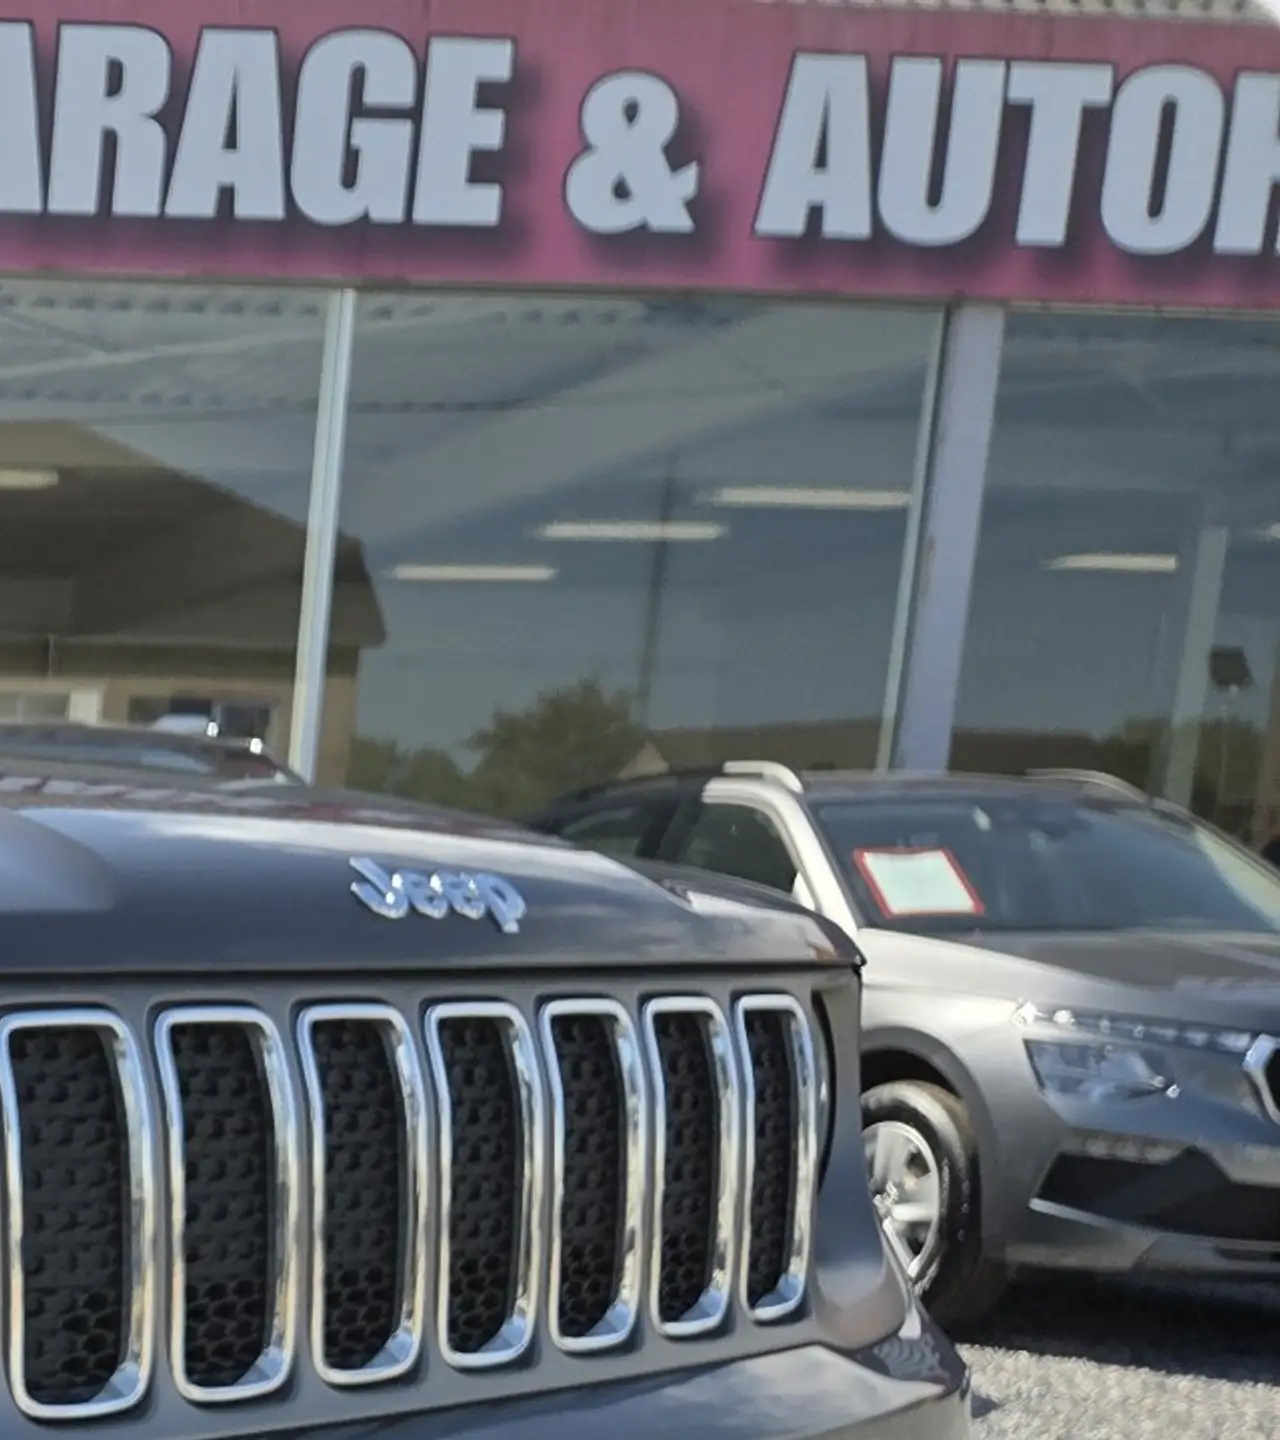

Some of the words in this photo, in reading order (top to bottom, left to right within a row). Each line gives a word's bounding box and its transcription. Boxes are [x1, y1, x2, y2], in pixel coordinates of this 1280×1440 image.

[560, 68, 700, 236] &
[752, 50, 1280, 257] AUTOH
[348, 856, 528, 934] Jeep
